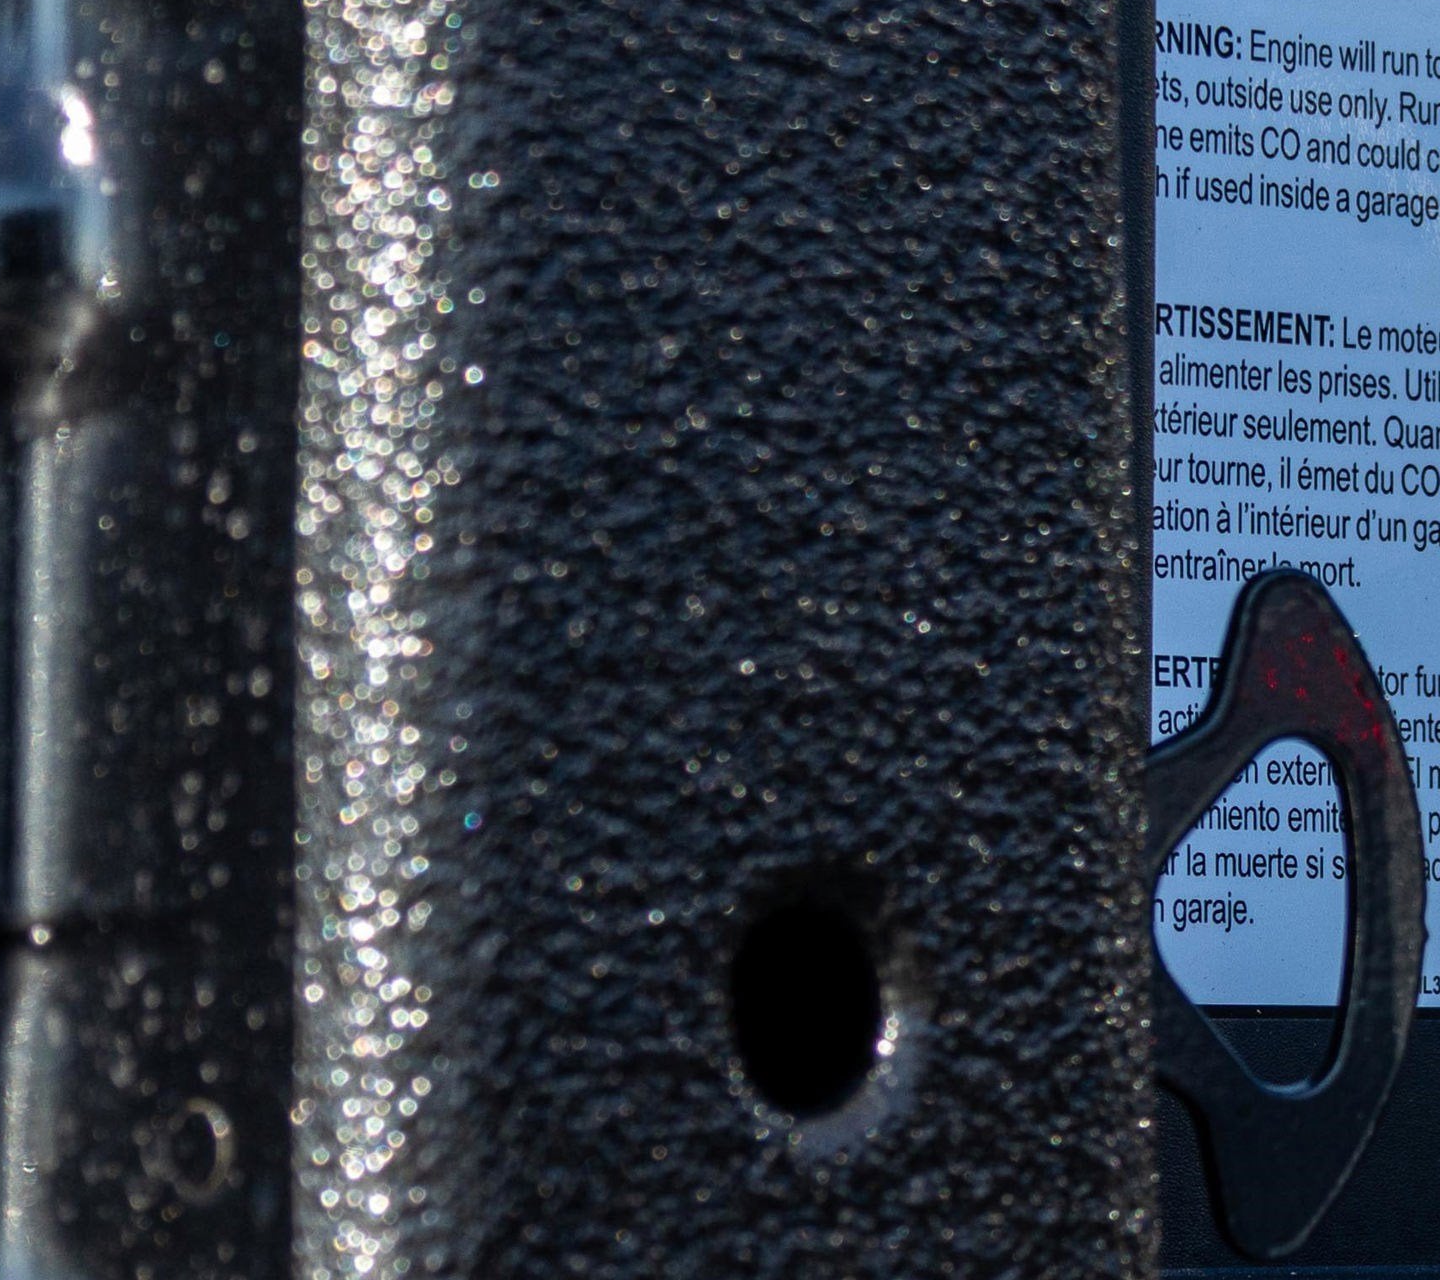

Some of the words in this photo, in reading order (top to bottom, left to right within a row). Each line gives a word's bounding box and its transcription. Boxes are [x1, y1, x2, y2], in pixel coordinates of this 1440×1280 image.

[1250, 29, 1333, 74] Engine
[1338, 39, 1376, 73] will
[1382, 50, 1419, 77] run
[1195, 76, 1283, 112] outside
[1290, 89, 1333, 117] use
[1338, 88, 1392, 130] only.
[1189, 122, 1255, 157] emits
[1260, 126, 1301, 161] CO
[1306, 133, 1351, 166] and
[1357, 138, 1421, 172] could
[1176, 166, 1191, 200] if
[1195, 172, 1253, 205] used
[1260, 173, 1330, 212] inside
[1335, 188, 1350, 213] a
[1155, 302, 1335, 348] RTISSEMENT:
[1343, 316, 1372, 351] Le
[1159, 352, 1273, 392] alimenter
[1278, 359, 1312, 395] les
[1318, 363, 1397, 404] prises.
[1243, 408, 1377, 447] seulement.
[1187, 452, 1272, 493] tourne,
[1280, 456, 1291, 489] il
[1297, 457, 1360, 493] émet
[1364, 461, 1394, 495] du
[1216, 500, 1231, 534] à
[1238, 501, 1352, 540] l’intérieur
[1356, 508, 1407, 543] d’un
[1154, 548, 1267, 583] entraîner
[1300, 556, 1361, 588] mort.
[1186, 843, 1207, 877] la
[1215, 847, 1299, 879] muerte
[1305, 846, 1324, 880] si
[1172, 891, 1254, 933] garaje.
